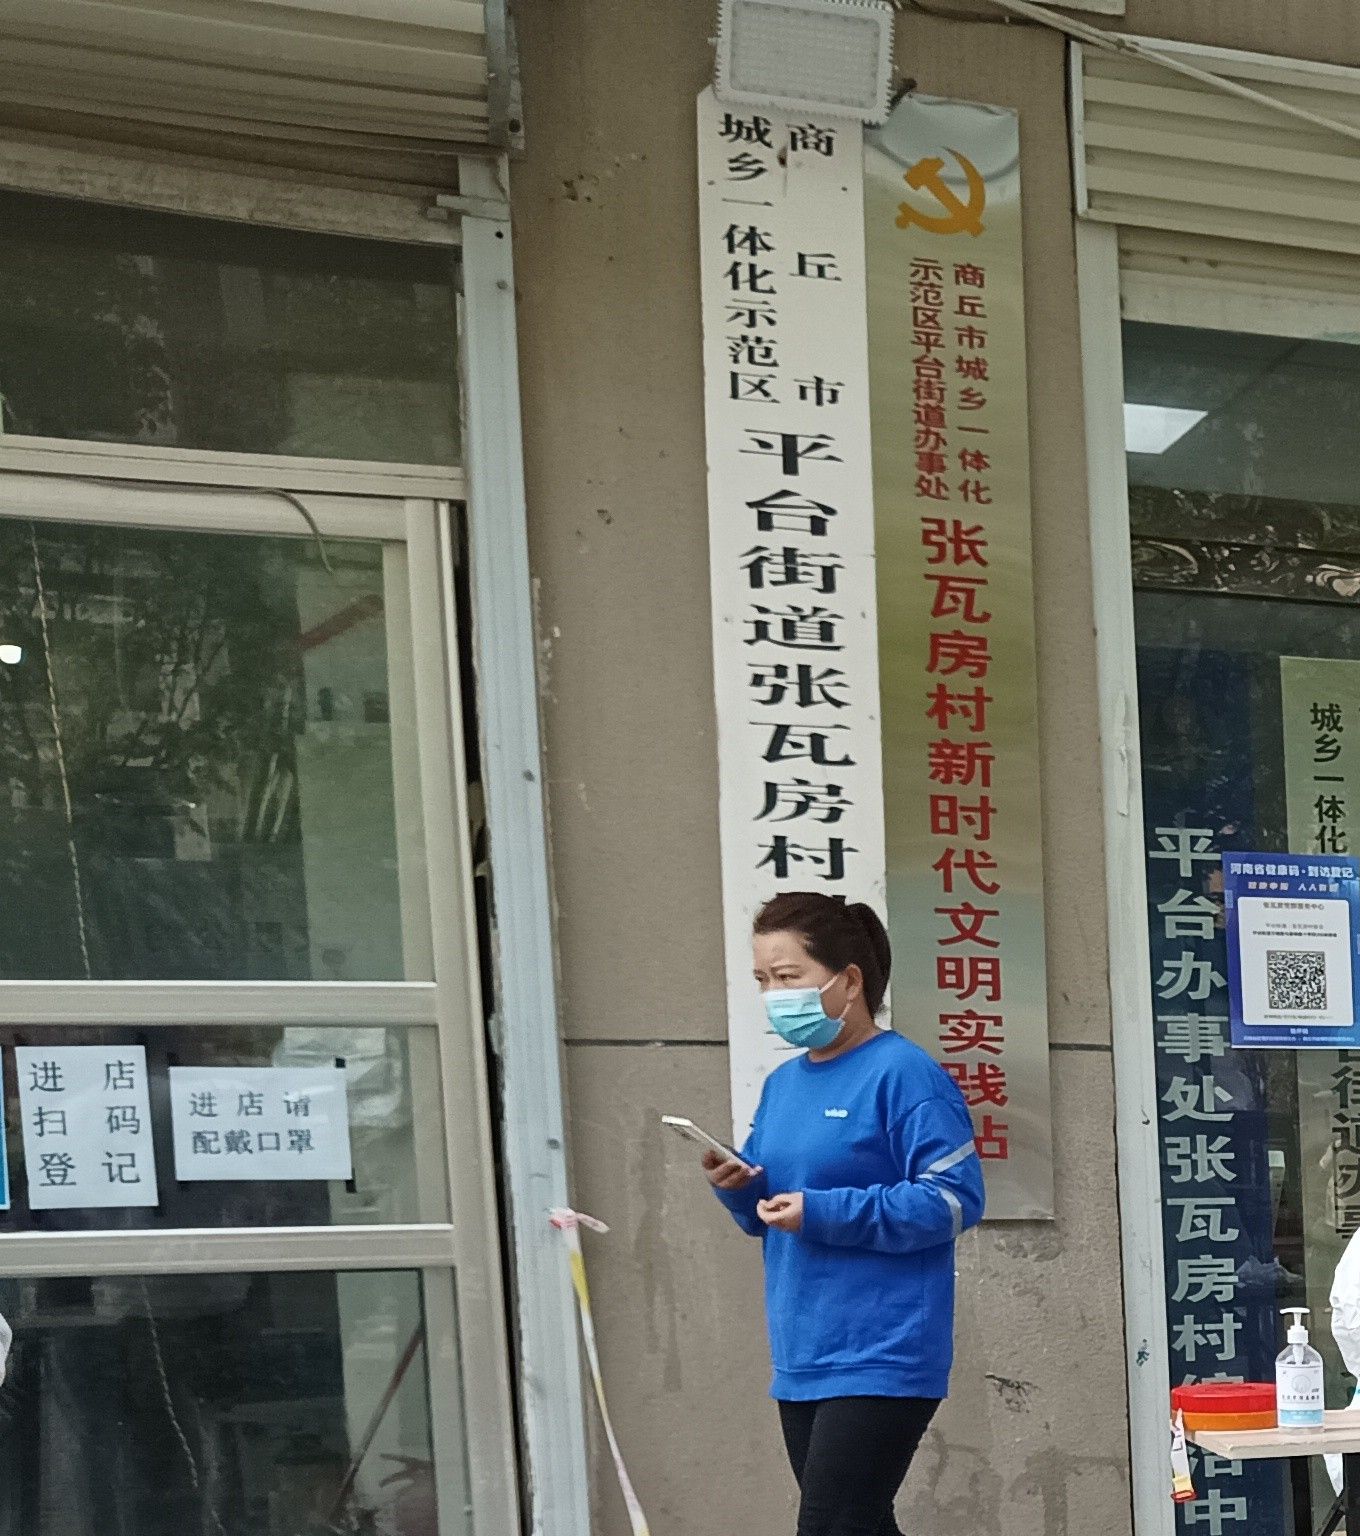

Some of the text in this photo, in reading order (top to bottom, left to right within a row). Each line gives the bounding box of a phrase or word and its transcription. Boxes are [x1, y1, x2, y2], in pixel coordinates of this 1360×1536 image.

[717, 112, 780, 406] 城乡一体化示范区
[785, 122, 846, 409] 商丘市
[907, 257, 950, 501] 示范区平台街道办事处
[951, 263, 993, 506] 商丘市城乡一体化
[738, 427, 859, 905] 平台街道张瓦房村
[1309, 702, 1349, 855] 城乡一体化
[192, 1128, 315, 1155] 配戴口罩
